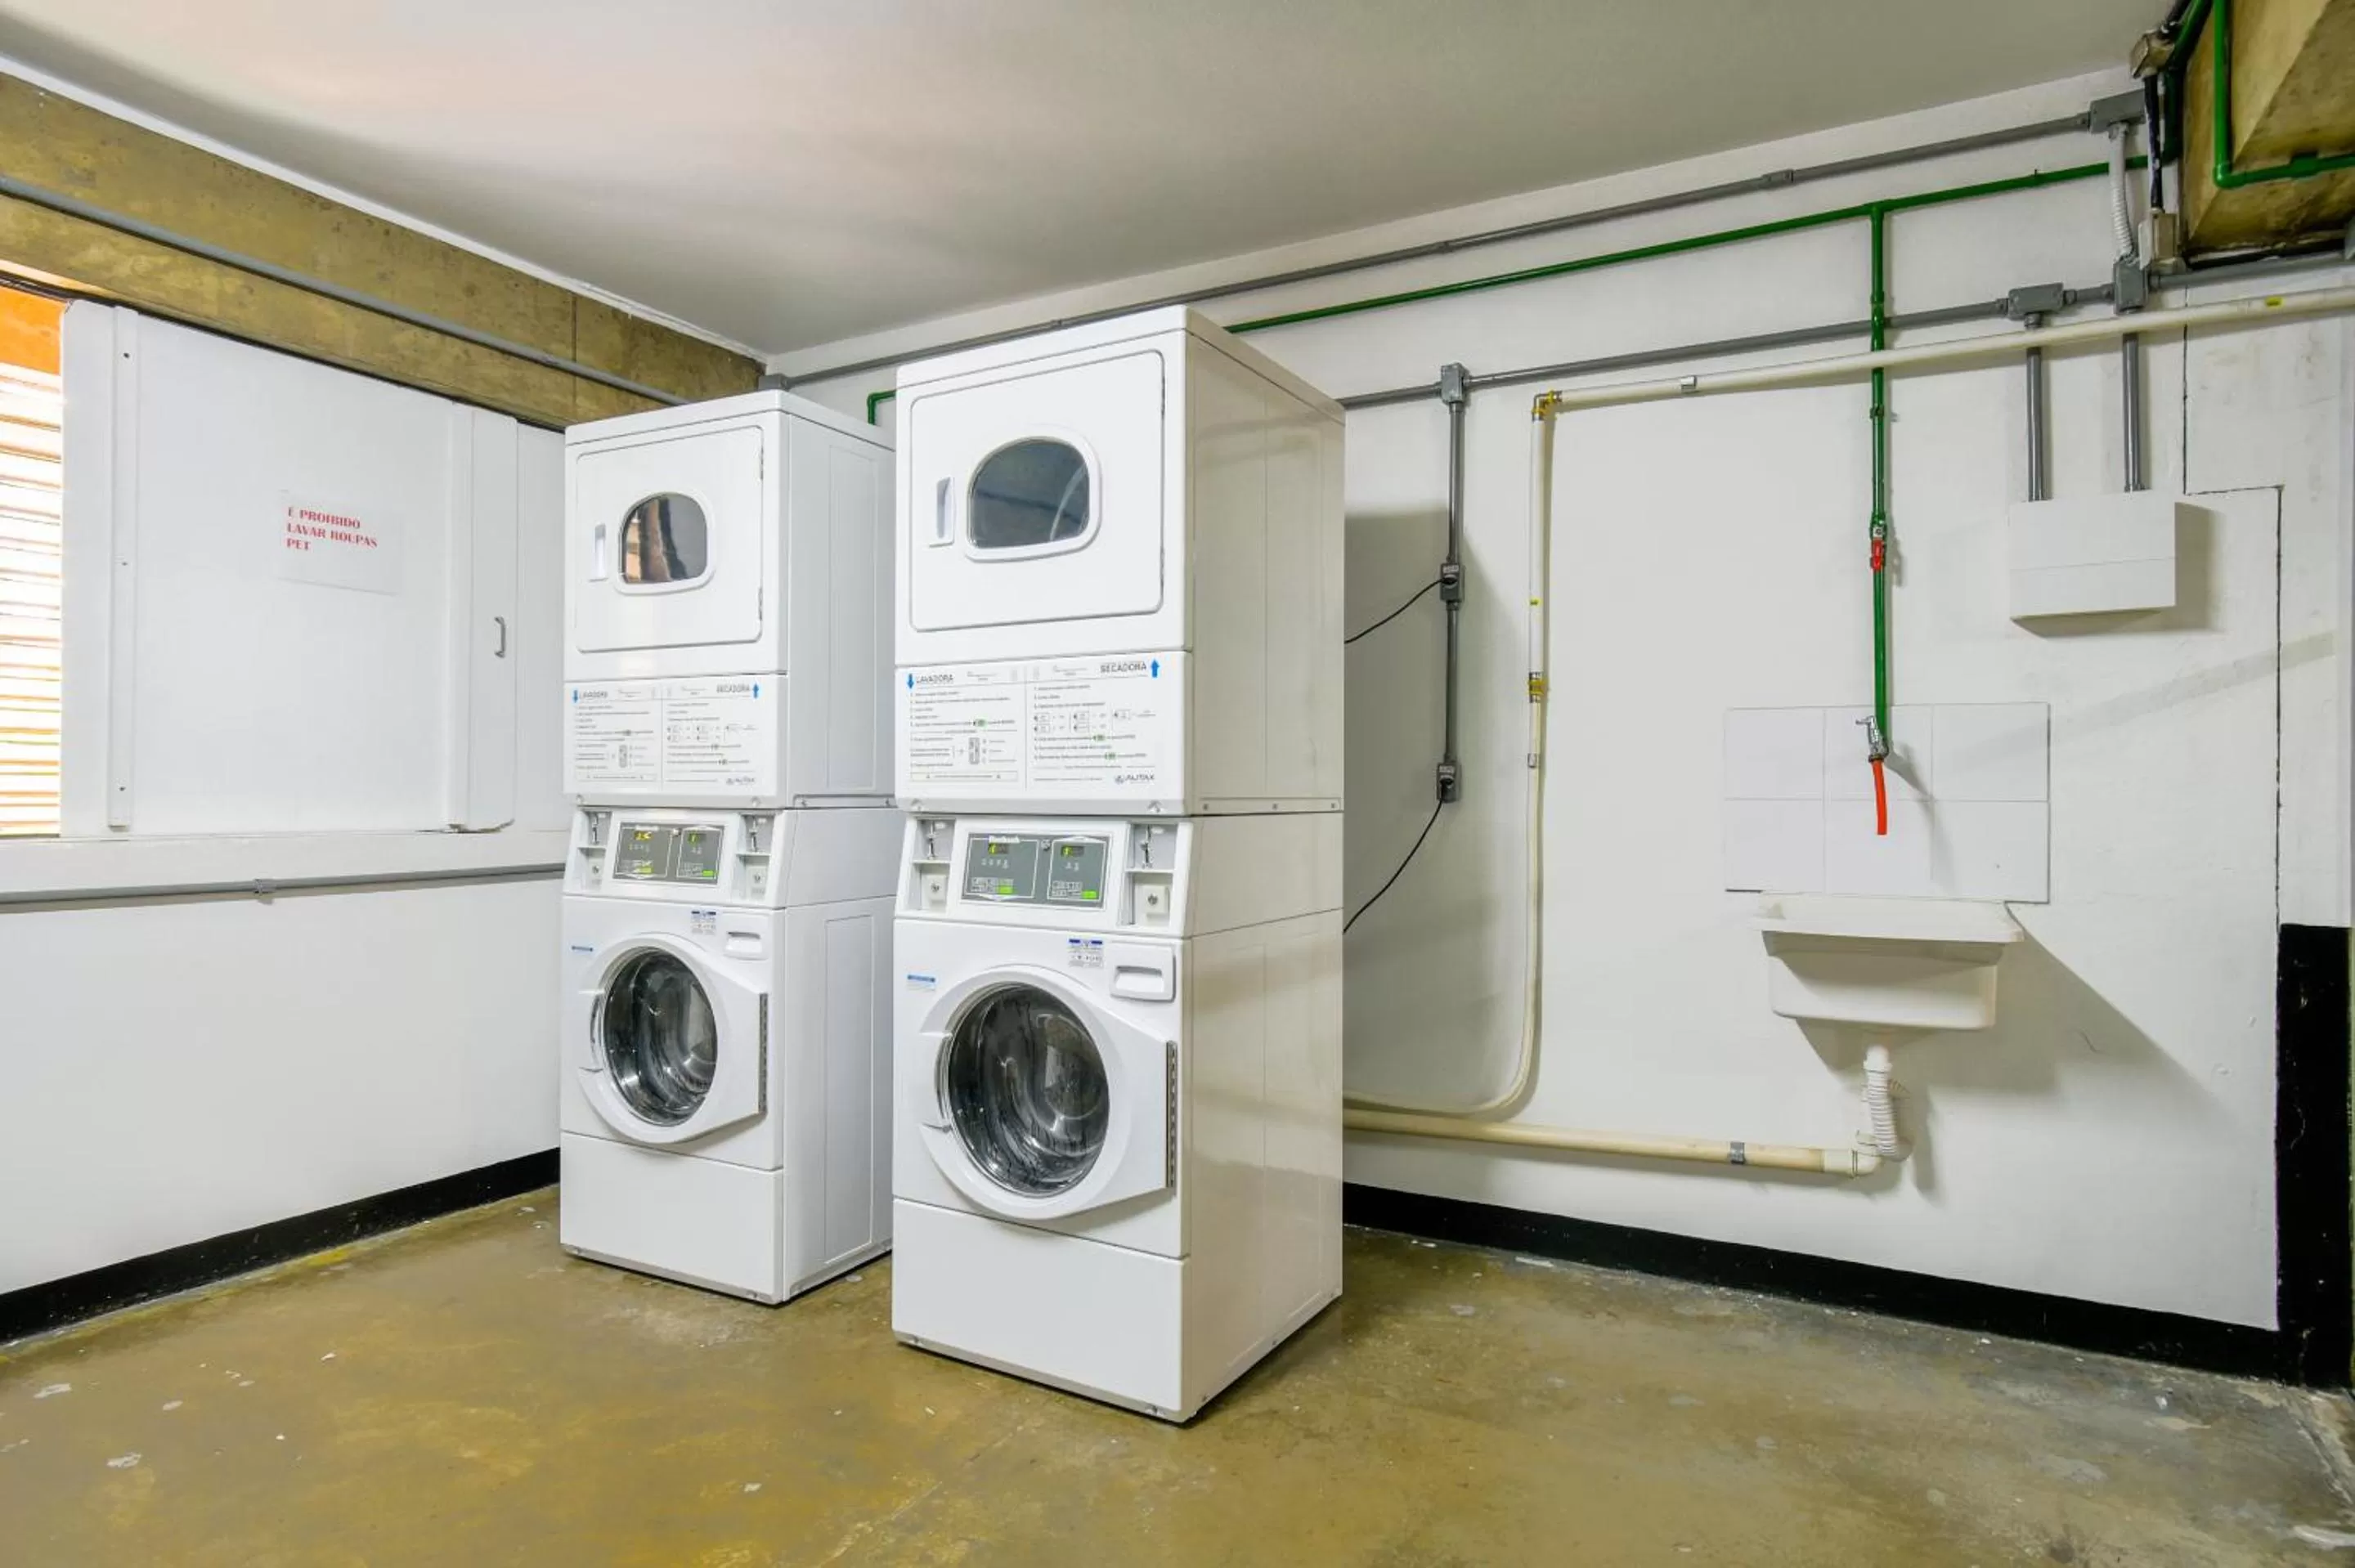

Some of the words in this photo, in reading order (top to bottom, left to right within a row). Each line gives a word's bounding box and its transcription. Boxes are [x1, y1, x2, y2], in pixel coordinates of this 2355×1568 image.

[300, 509, 361, 529] PROIBIDO
[287, 522, 326, 539] LAVAR
[330, 530, 378, 548] ROUPAS
[287, 538, 311, 551] PET
[1101, 661, 1147, 673] SECADORA
[917, 674, 954, 685] LAVADORA
